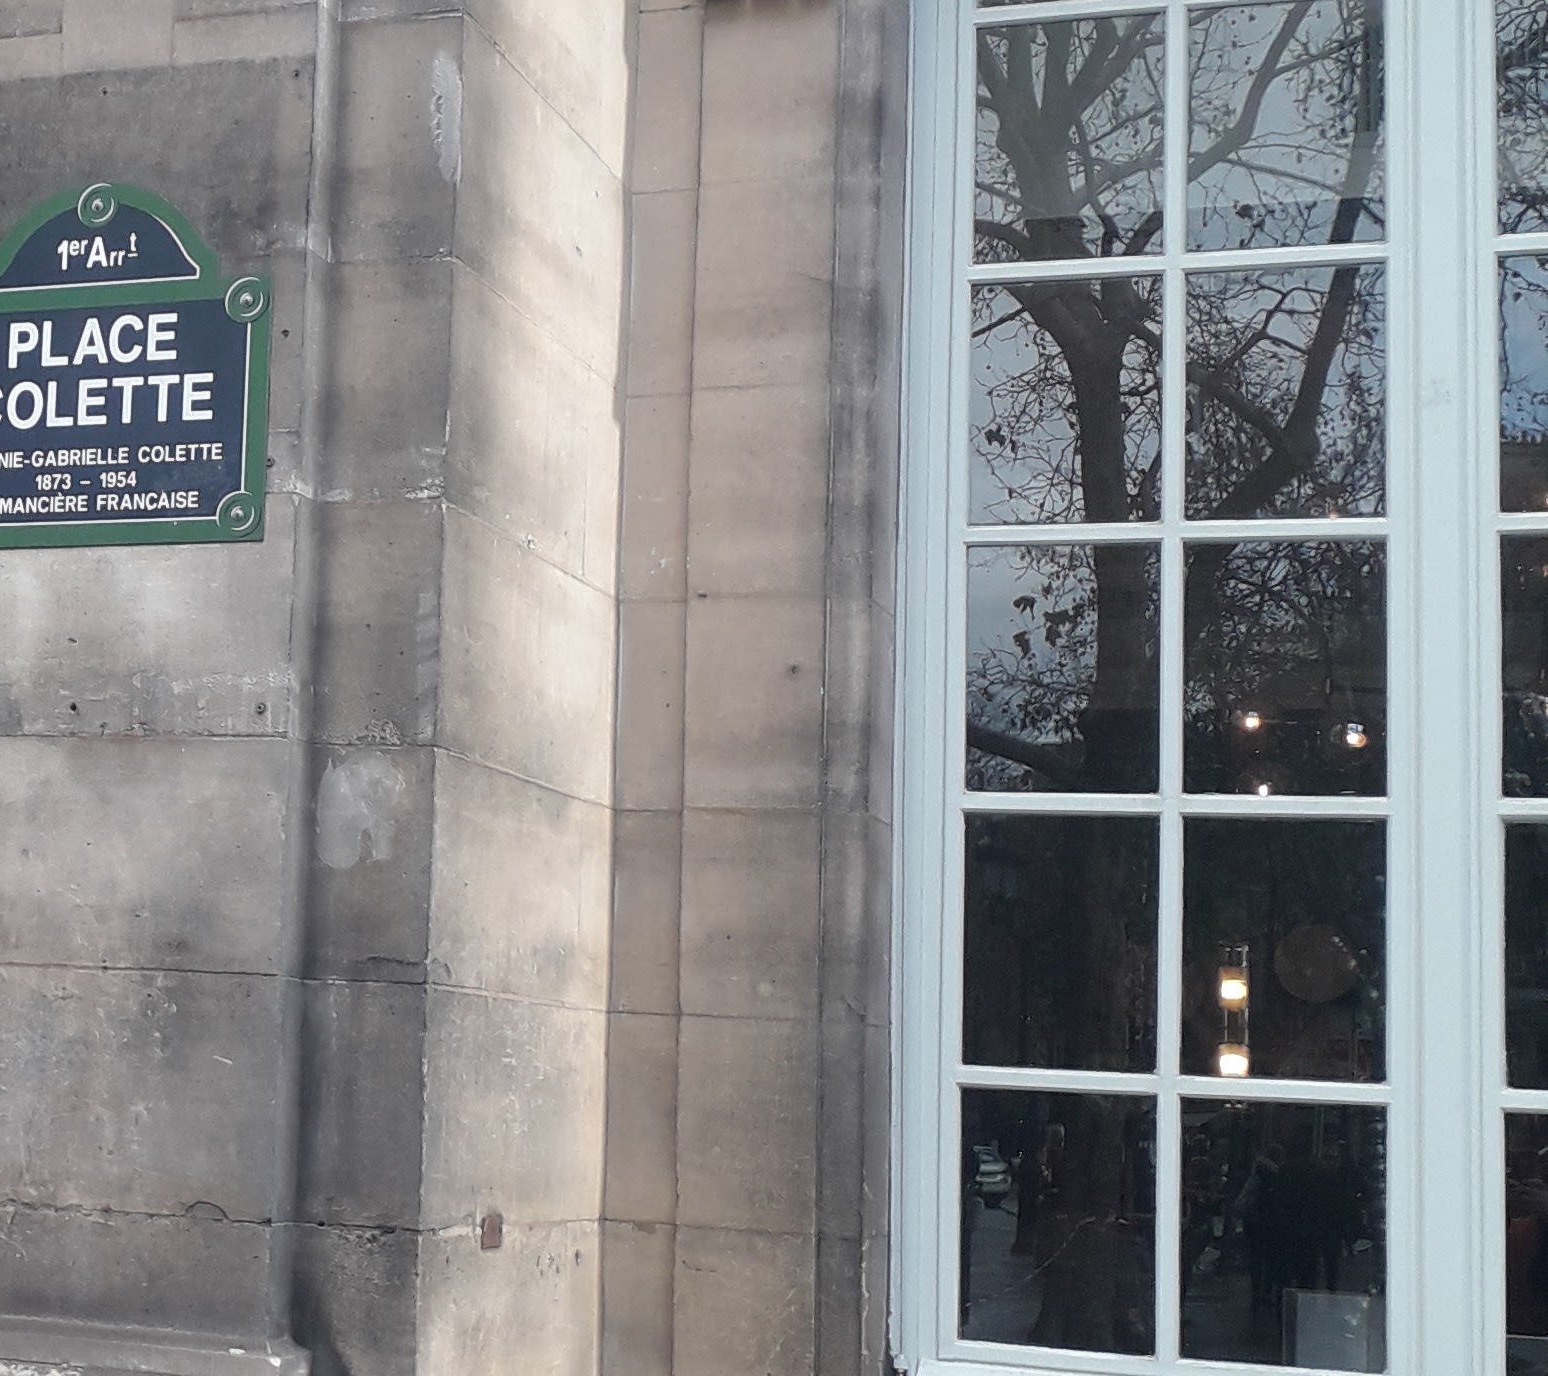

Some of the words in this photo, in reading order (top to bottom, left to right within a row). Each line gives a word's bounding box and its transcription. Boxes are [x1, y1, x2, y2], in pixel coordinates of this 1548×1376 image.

[7, 312, 179, 369] PLACE
[137, 442, 223, 464] COLETTE
[35, 473, 72, 491] 1873
[99, 470, 137, 488] 1954
